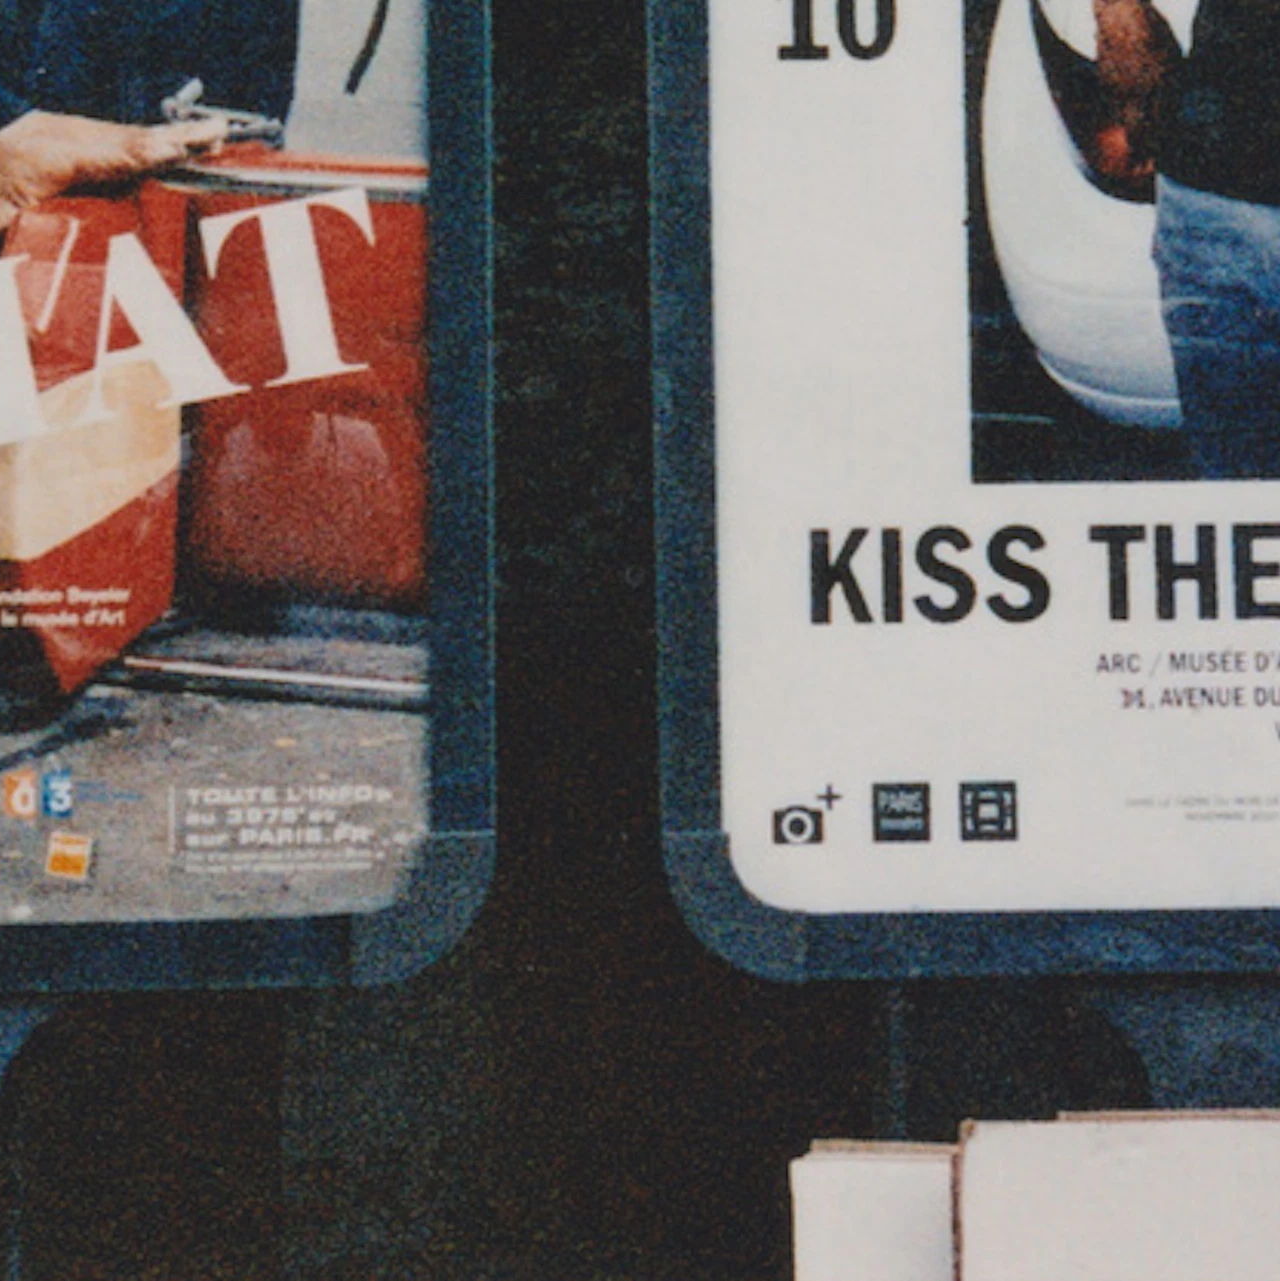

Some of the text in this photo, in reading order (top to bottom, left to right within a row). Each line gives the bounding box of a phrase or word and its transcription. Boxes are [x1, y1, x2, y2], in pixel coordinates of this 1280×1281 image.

[807, 524, 1053, 625] KISS
[1096, 652, 1141, 673] ARC
[1169, 648, 1248, 673] MUSÉE
[1160, 686, 1247, 709] AVENUE
